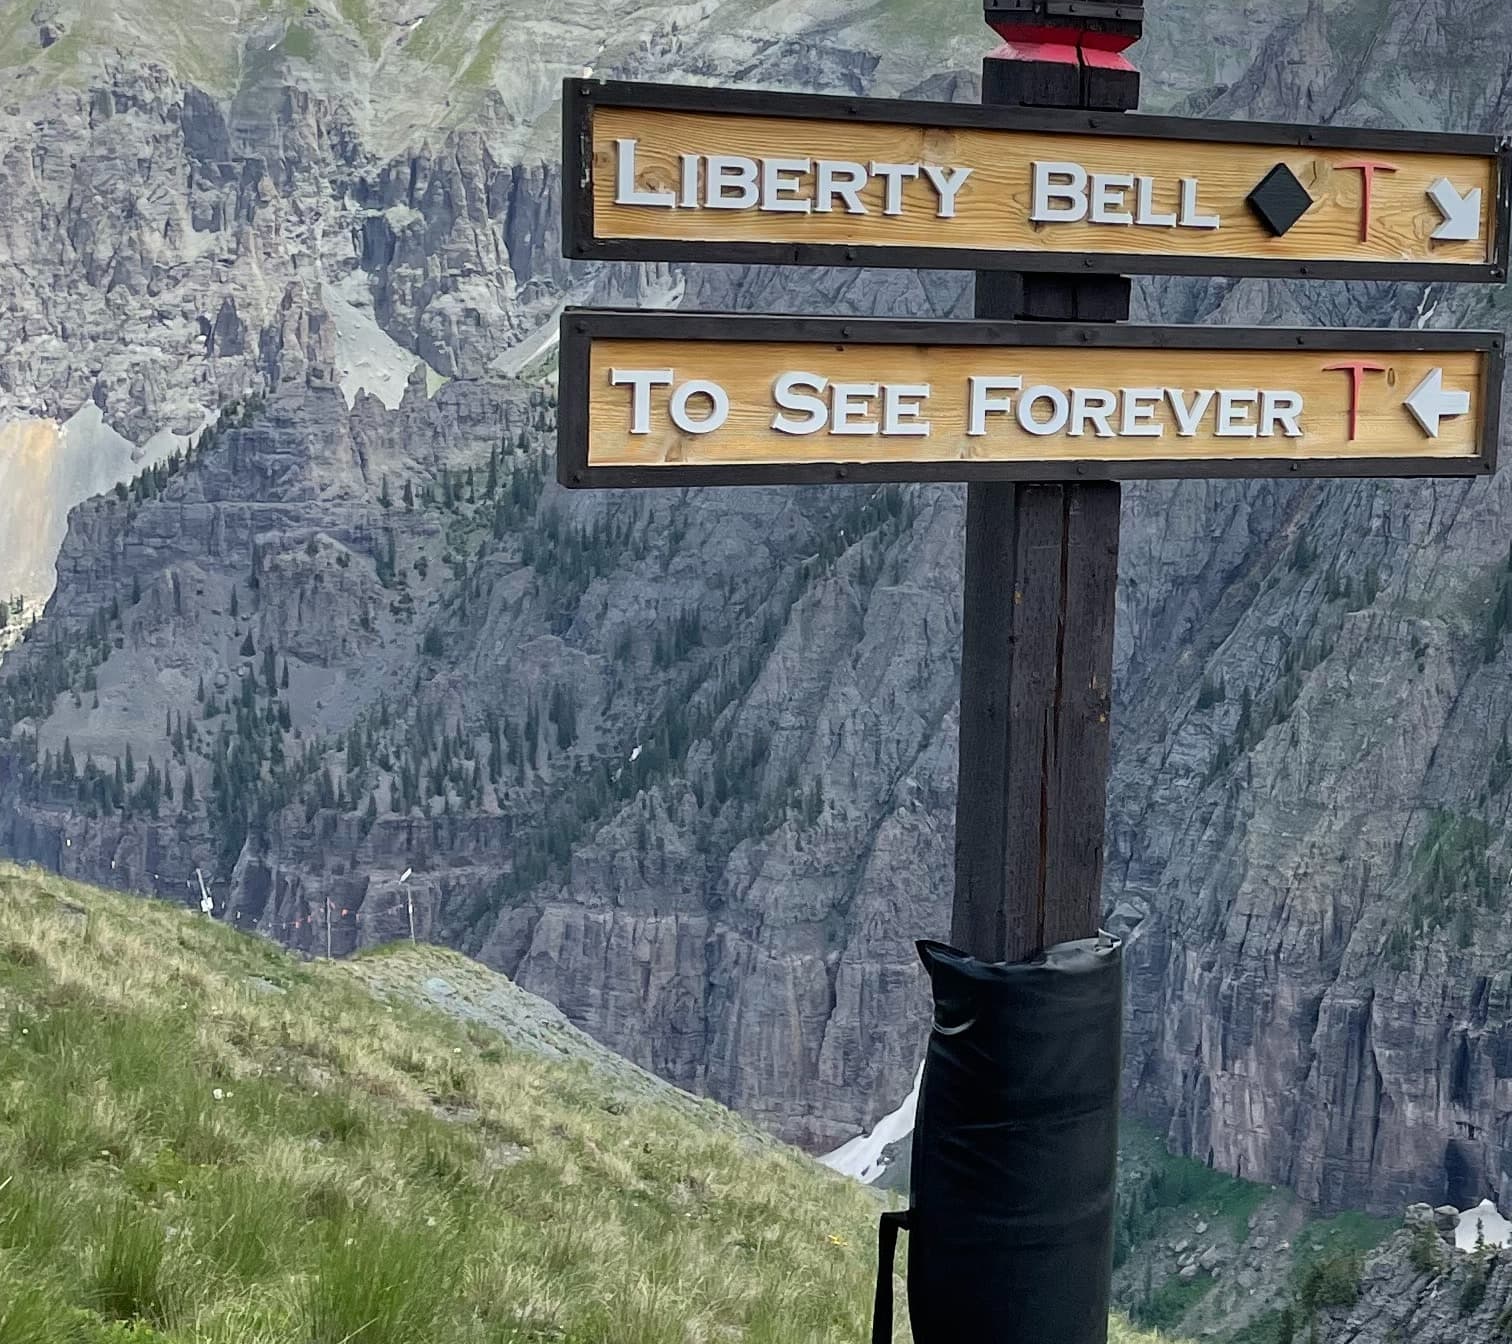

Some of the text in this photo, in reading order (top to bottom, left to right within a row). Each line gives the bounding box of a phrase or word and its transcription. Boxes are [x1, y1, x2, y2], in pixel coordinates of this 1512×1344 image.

[615, 138, 974, 217] LIBERTY
[1030, 161, 1220, 230] BELL
[609, 368, 729, 434] TO
[770, 371, 930, 436] SEE
[967, 375, 1303, 438] FOREVER
